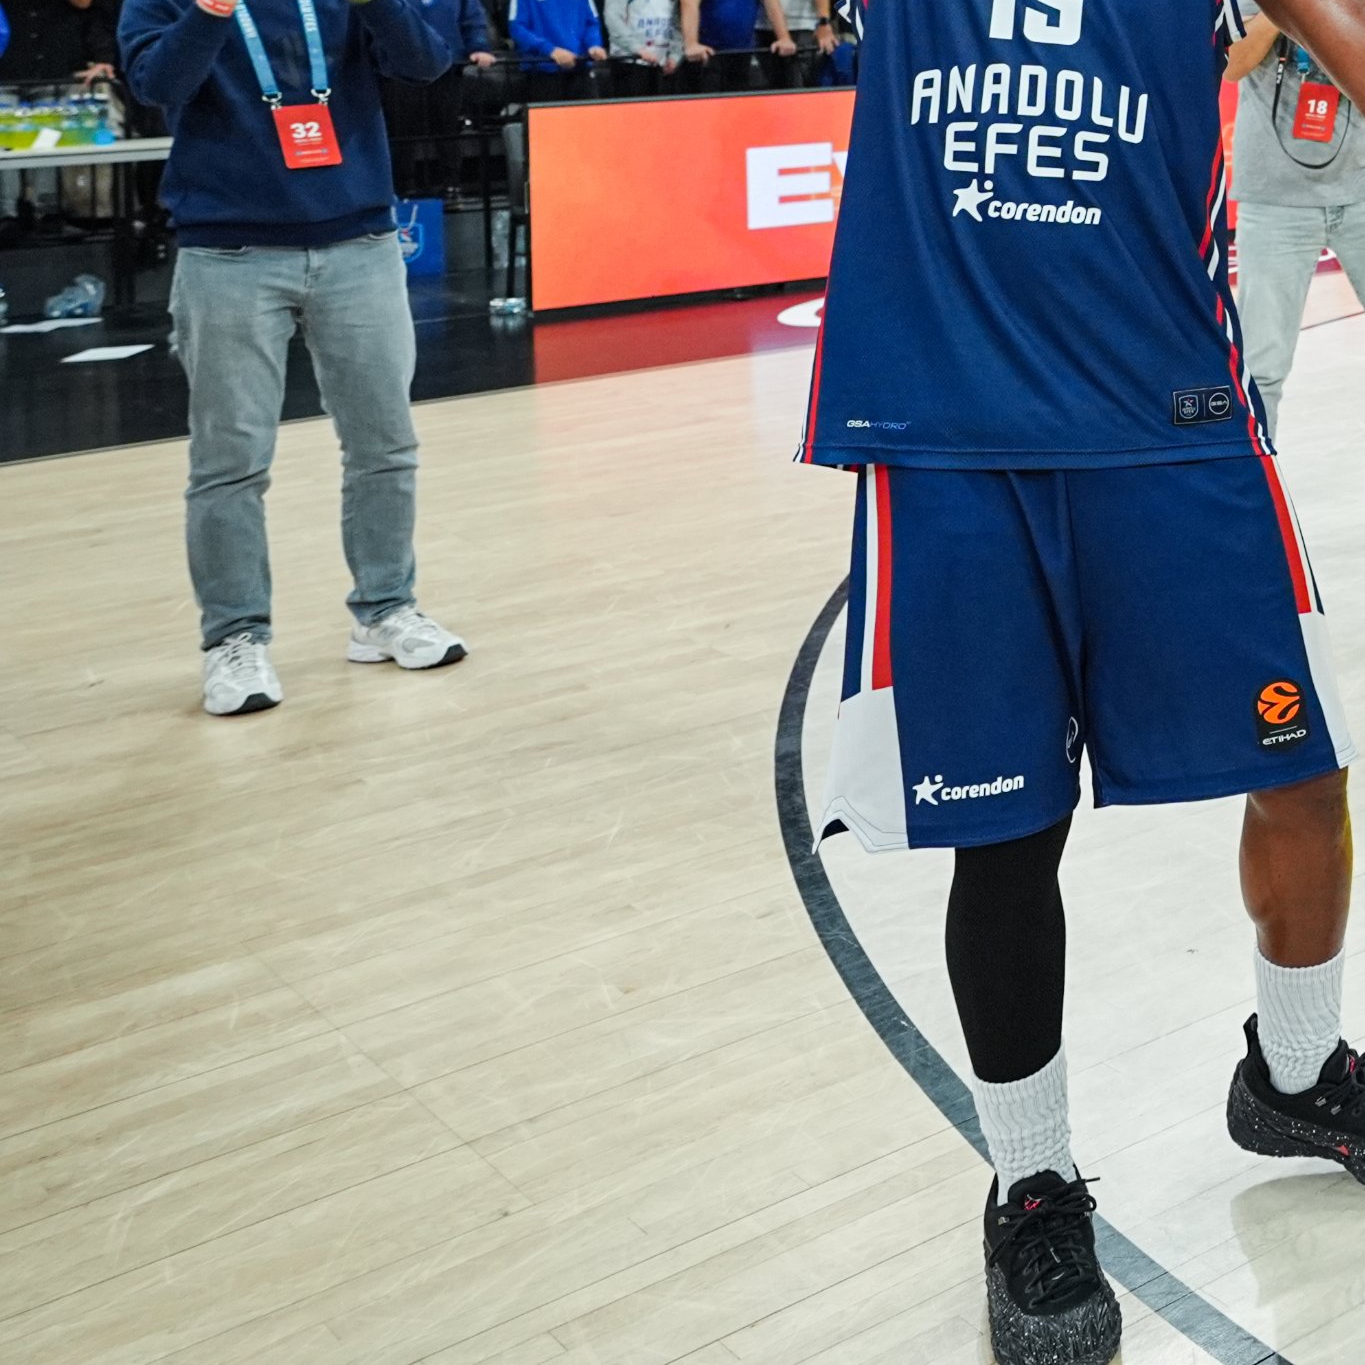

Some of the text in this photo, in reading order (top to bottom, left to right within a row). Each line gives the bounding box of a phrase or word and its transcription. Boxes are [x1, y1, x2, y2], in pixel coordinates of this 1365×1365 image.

[911, 63, 1148, 144] ANADOLU
[1307, 99, 1328, 114] 18
[290, 121, 322, 139] 32
[943, 122, 1111, 182] EFES
[987, 196, 1102, 226] corendon
[1262, 729, 1307, 746] ETIHAD
[941, 774, 1025, 802] corendon
